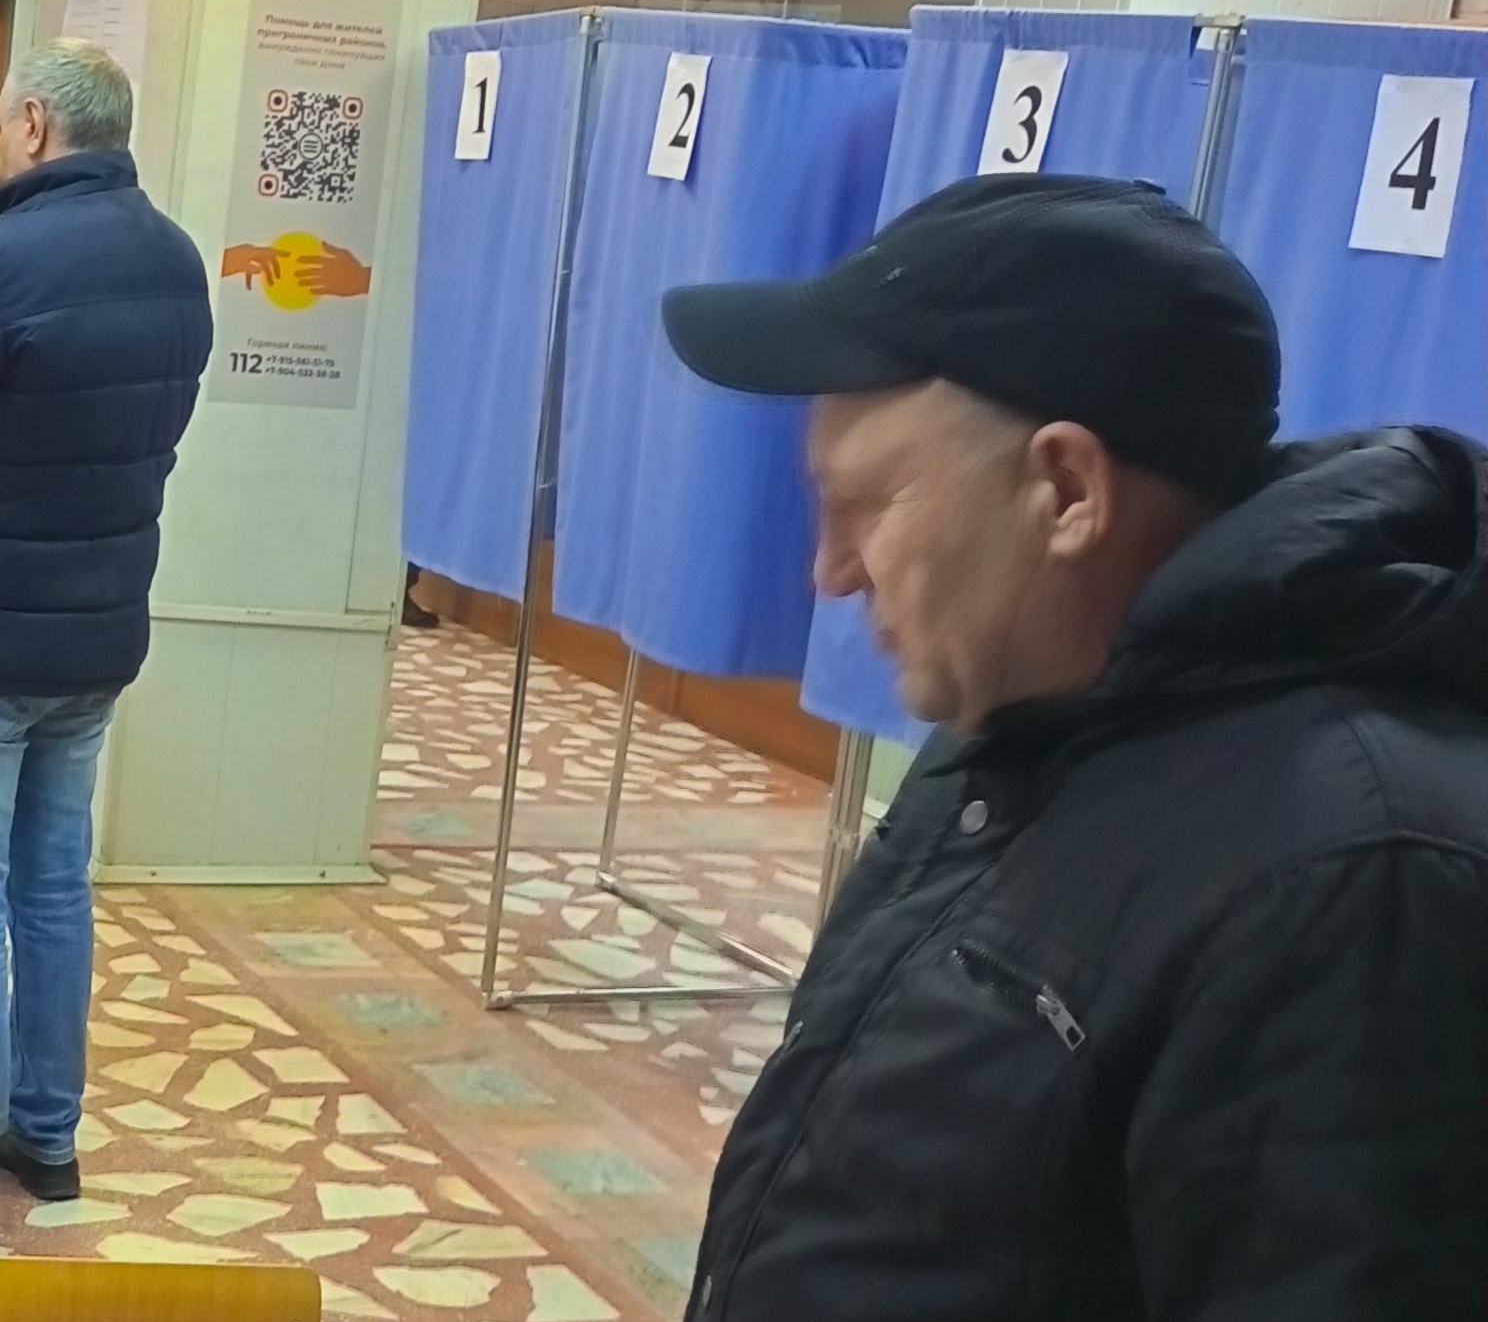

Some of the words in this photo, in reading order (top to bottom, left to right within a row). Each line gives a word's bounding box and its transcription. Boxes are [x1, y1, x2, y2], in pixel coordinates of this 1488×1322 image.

[265, 14, 310, 28] Помощь
[312, 21, 333, 30] для
[335, 24, 383, 35] жителей
[471, 77, 488, 134] 1
[668, 82, 695, 149] 2
[1002, 85, 1042, 163] 3
[1388, 118, 1440, 210] 4
[230, 352, 263, 374] 112
[248, 338, 290, 349] Горячая
